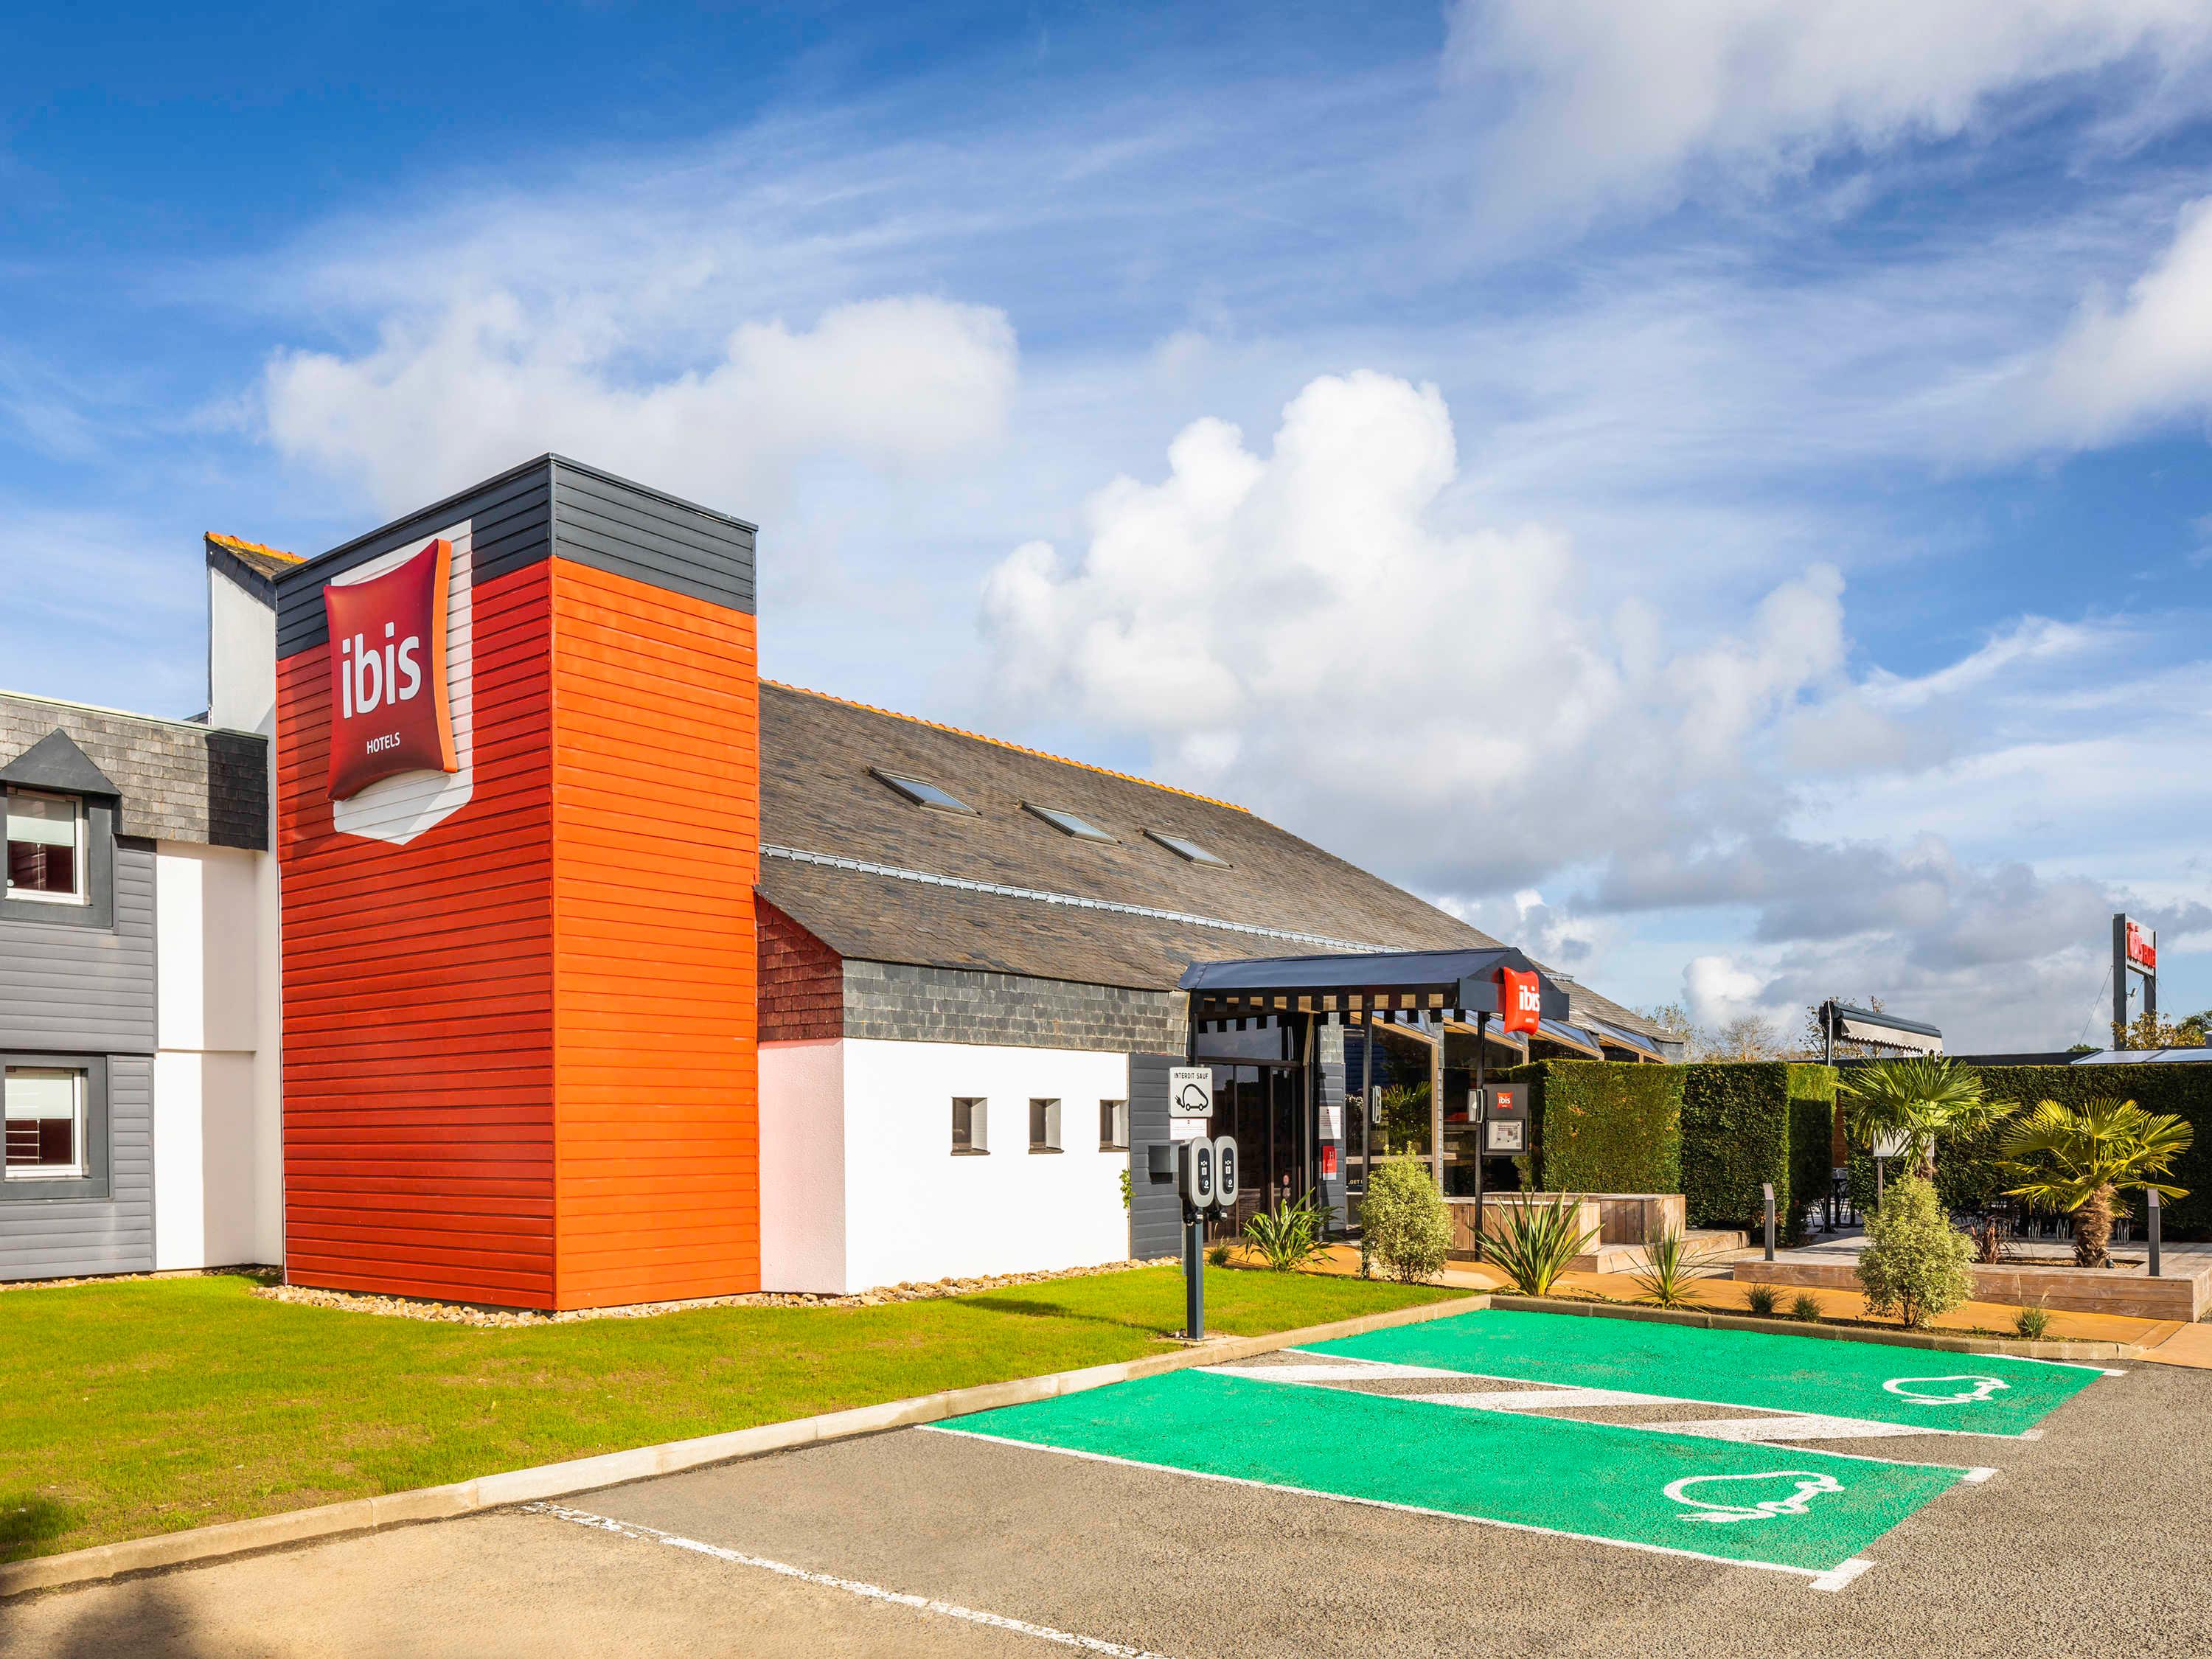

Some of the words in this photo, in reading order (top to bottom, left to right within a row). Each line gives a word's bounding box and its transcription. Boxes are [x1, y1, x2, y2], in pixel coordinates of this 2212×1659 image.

[342, 622, 422, 719] ibis
[366, 732, 400, 754] HOTELS
[1519, 984, 1540, 1012] ibis
